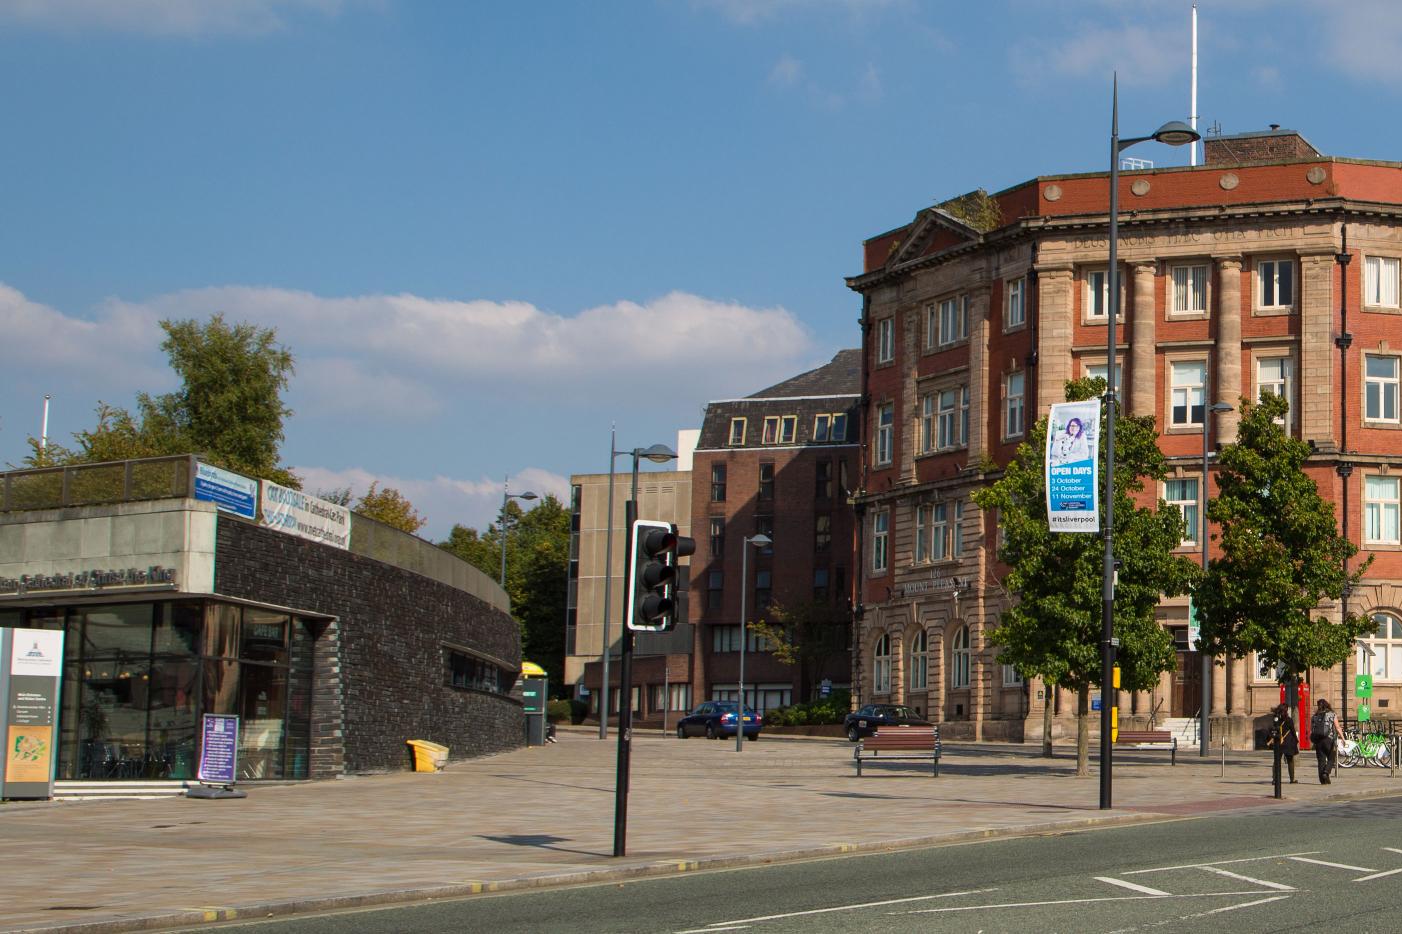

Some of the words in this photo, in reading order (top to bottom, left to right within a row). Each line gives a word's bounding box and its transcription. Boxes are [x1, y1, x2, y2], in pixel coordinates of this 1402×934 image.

[1051, 467, 1071, 475] OPEN
[1073, 467, 1092, 475] DAYS
[904, 581, 928, 593] MOUNT
